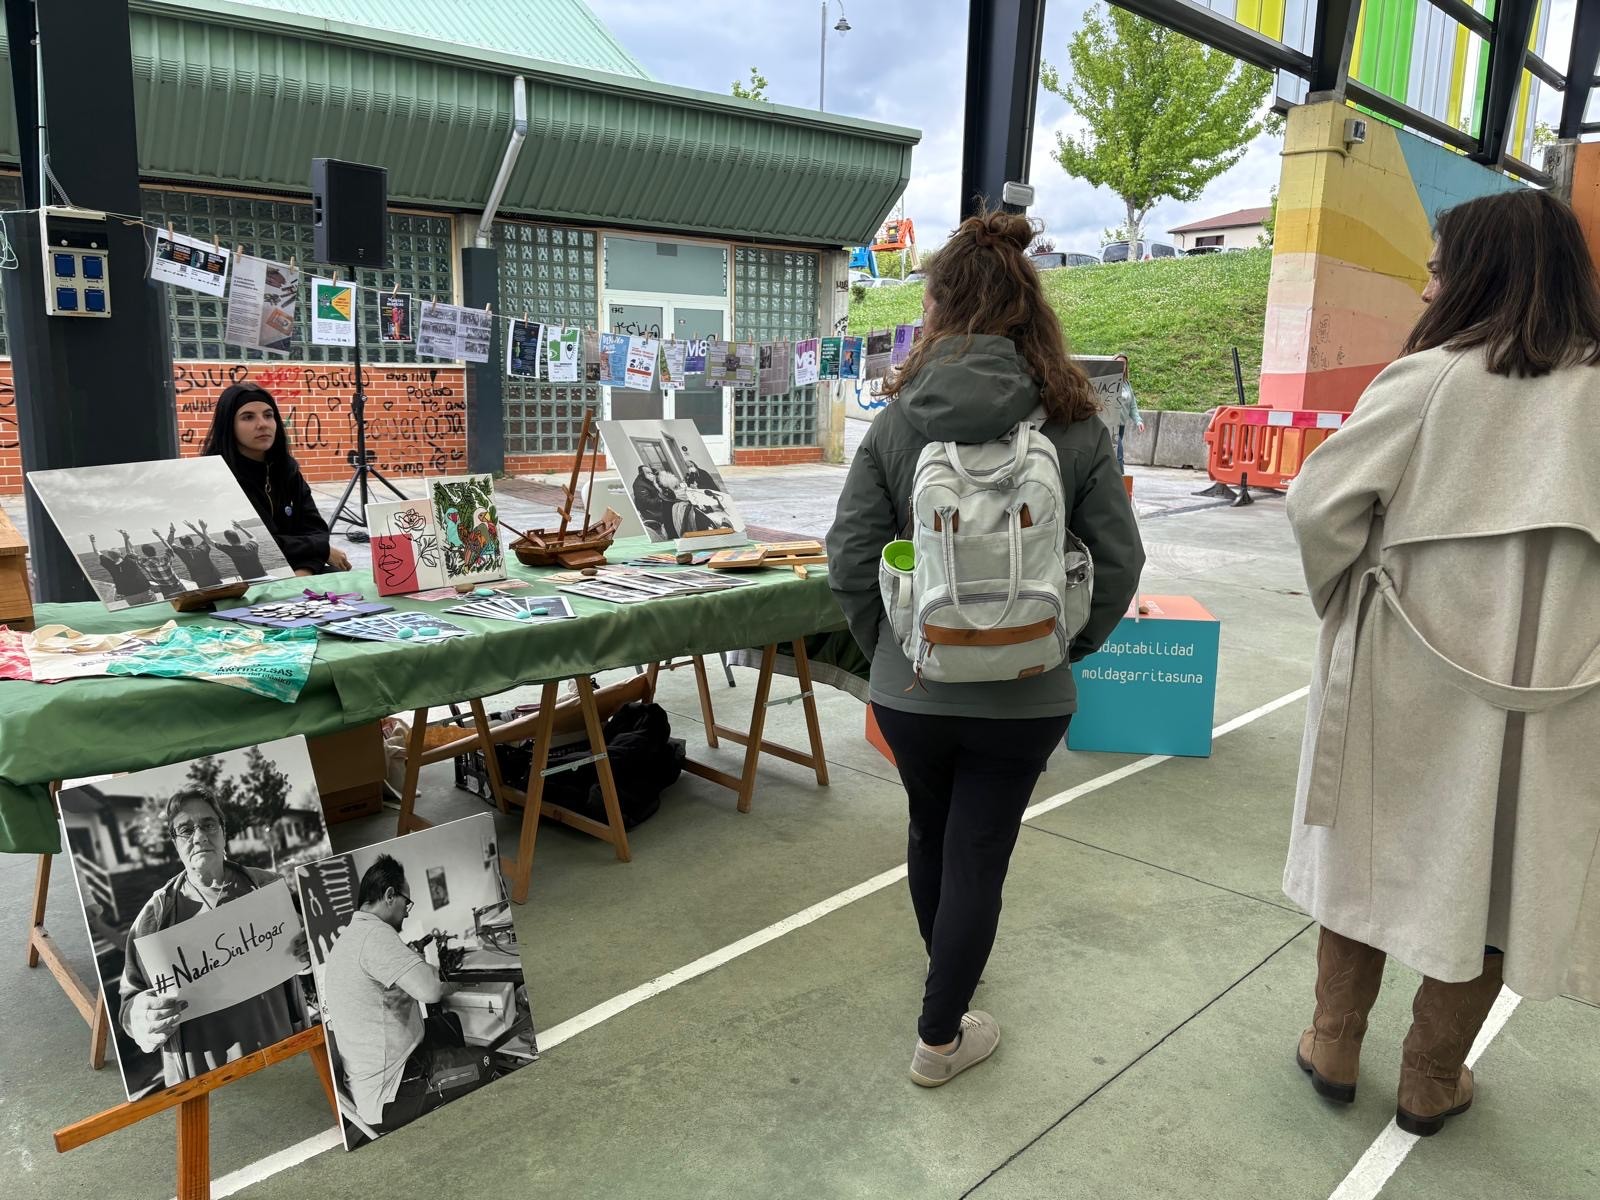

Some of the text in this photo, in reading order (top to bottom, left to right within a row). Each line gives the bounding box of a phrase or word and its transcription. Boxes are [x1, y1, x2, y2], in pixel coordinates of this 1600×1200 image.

[685, 339, 707, 357] M8
[796, 350, 816, 369] M8
[1081, 667, 1203, 684] moldagarritasuna
[155, 922, 285, 994] #NadieSinHogar
